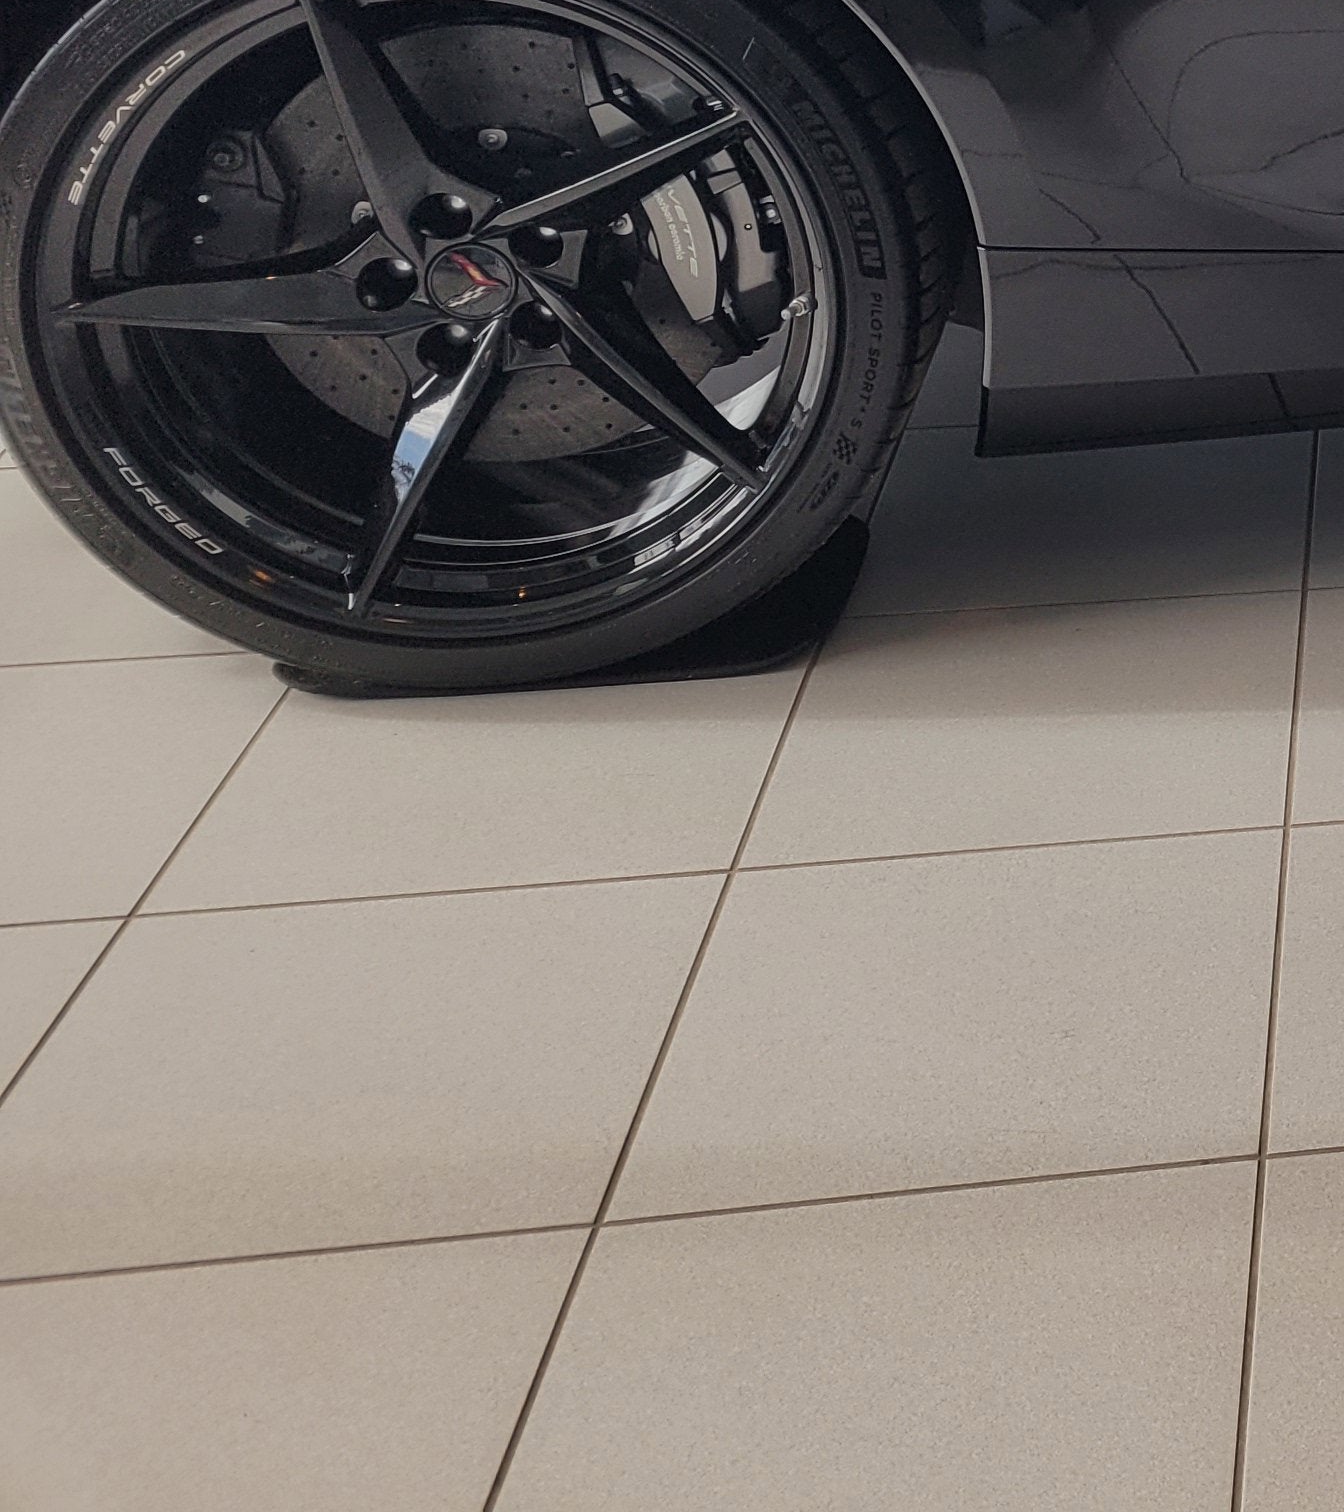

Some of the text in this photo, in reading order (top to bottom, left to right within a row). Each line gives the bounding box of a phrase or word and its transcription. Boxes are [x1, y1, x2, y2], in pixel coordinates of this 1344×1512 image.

[67, 49, 186, 206] CORVETTE
[791, 100, 882, 268] MICHELIN
[668, 222, 684, 261] ceramic
[870, 292, 883, 341] PILOT
[860, 347, 880, 405] SPORT
[850, 417, 863, 429] S
[103, 448, 224, 555] FORGED
